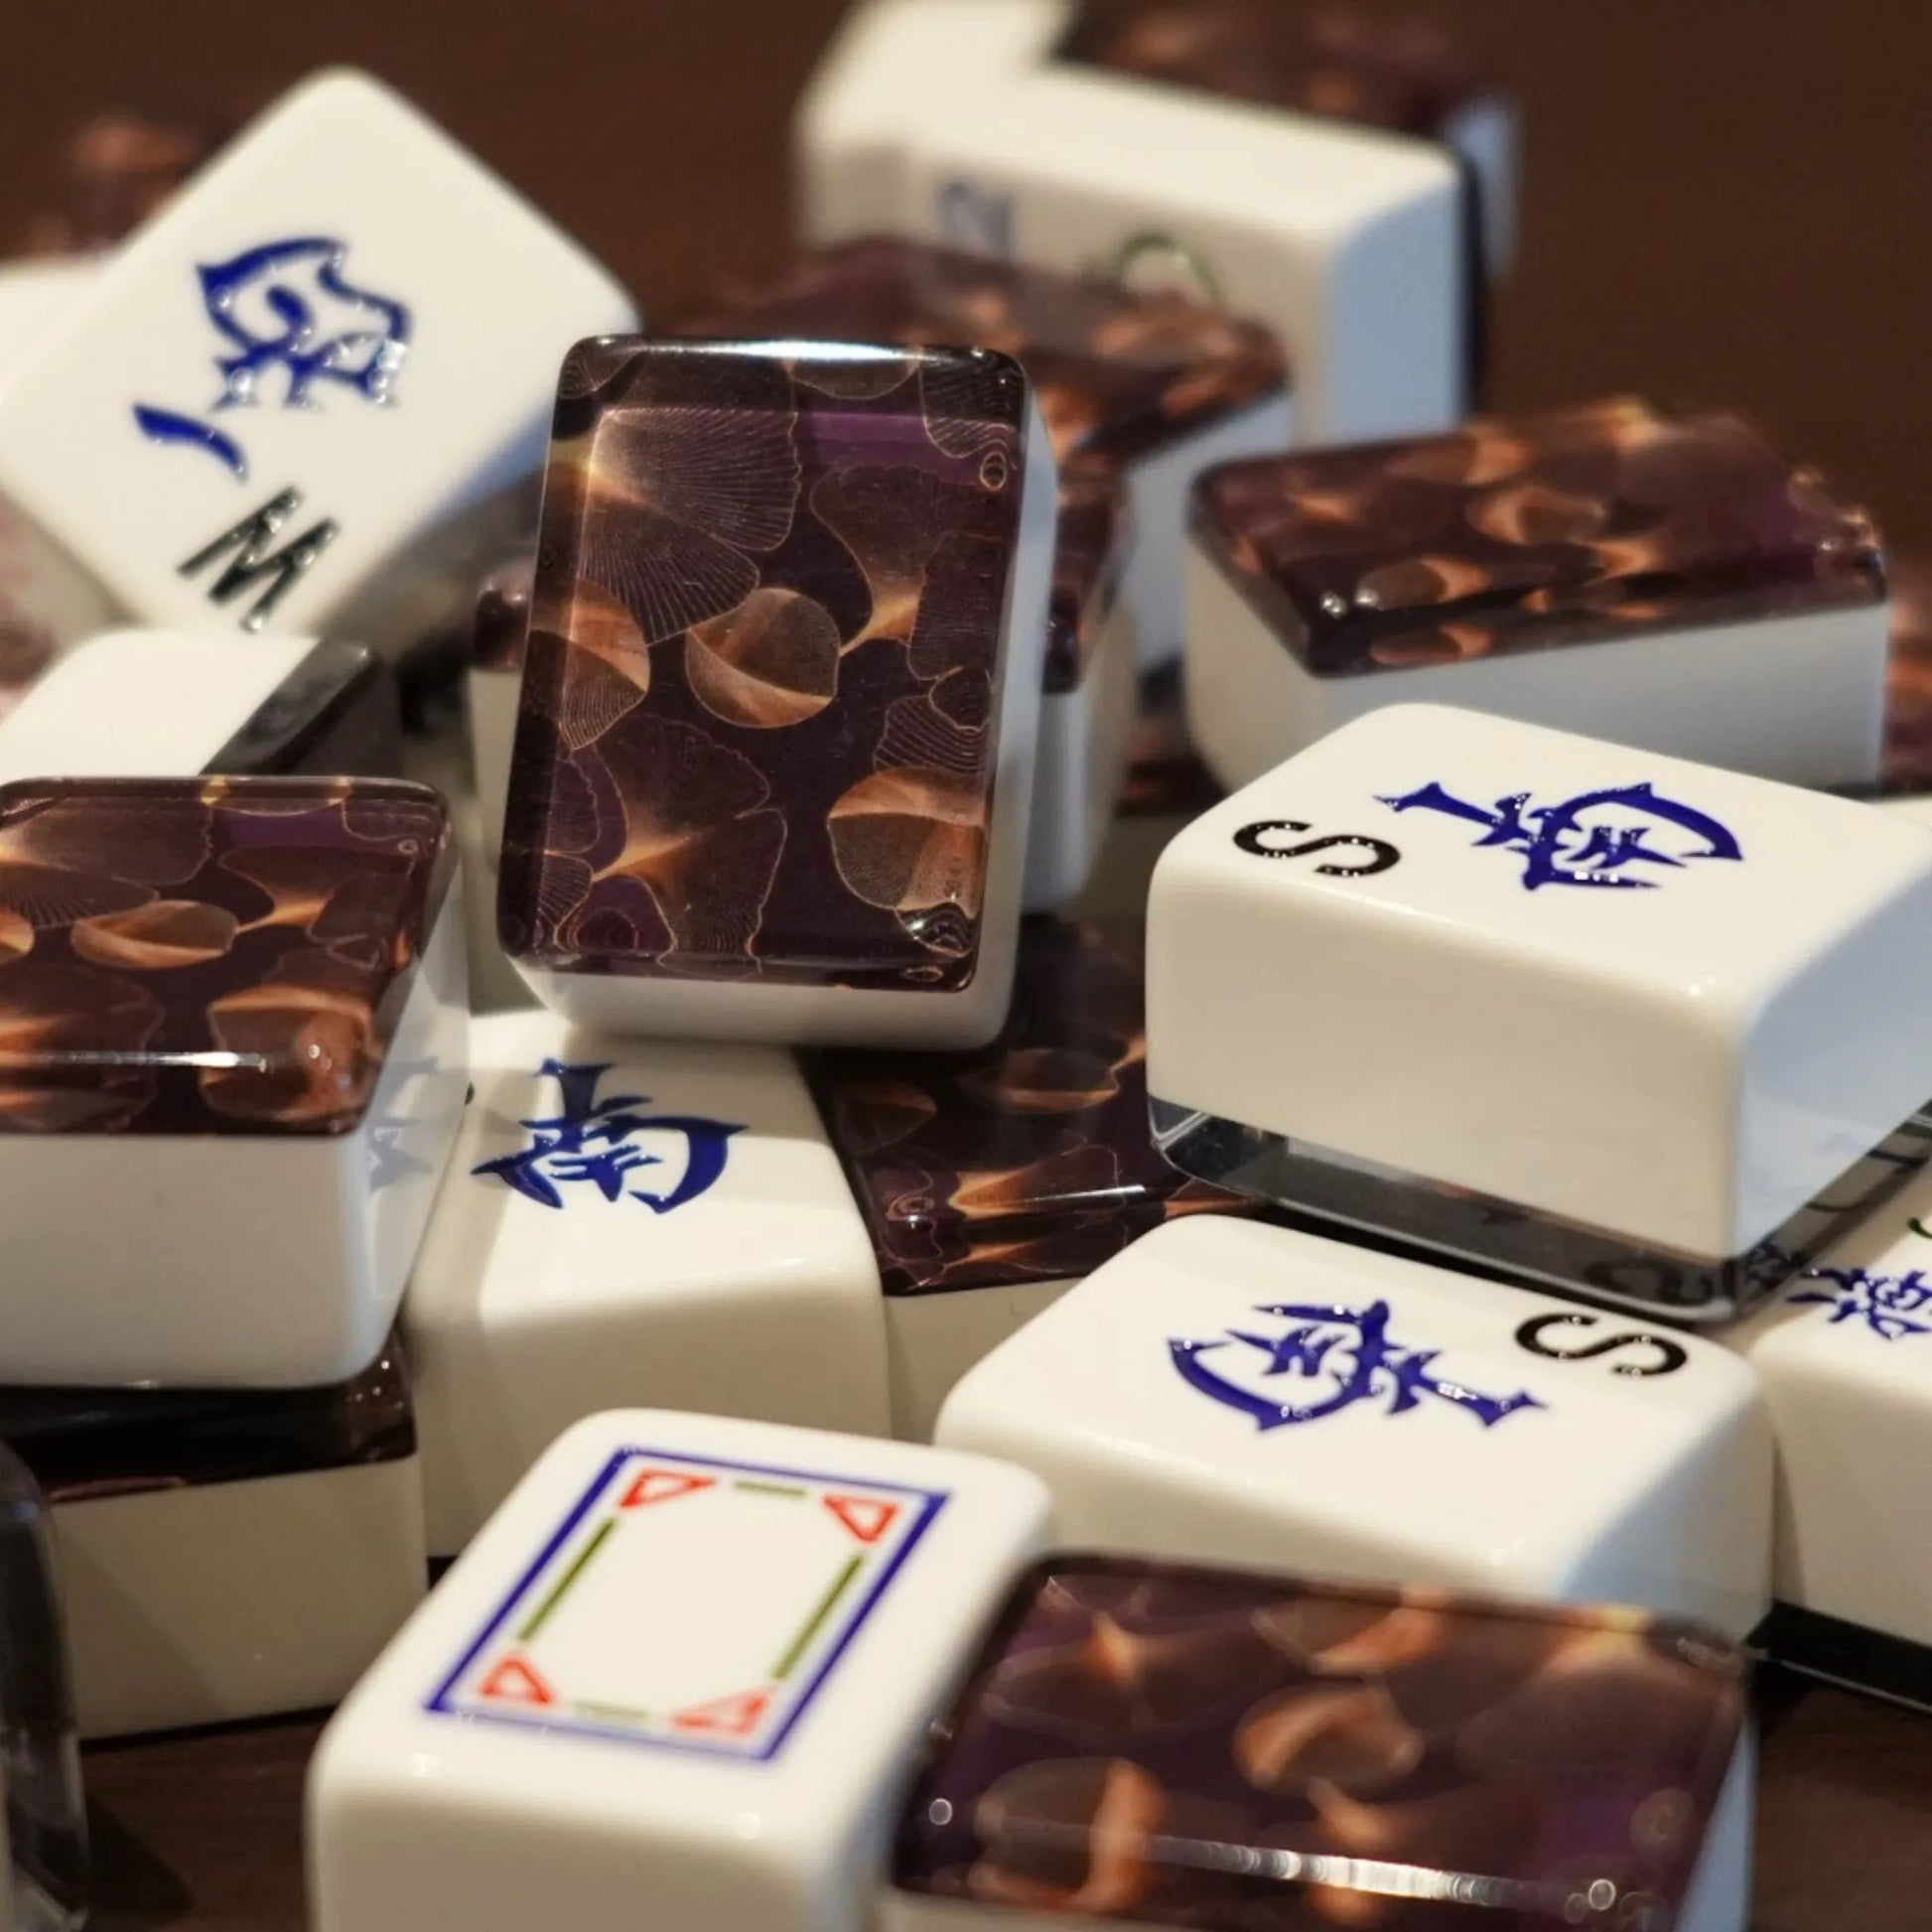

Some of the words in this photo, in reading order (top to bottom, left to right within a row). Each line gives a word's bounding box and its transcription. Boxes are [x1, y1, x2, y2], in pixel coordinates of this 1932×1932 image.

[134, 235, 410, 483] 西
[1233, 819, 1401, 877] S
[1372, 781, 1742, 892] 南
[470, 1057, 749, 1214] 南
[1168, 1299, 1549, 1432] 南
[1516, 1311, 1689, 1377] S
